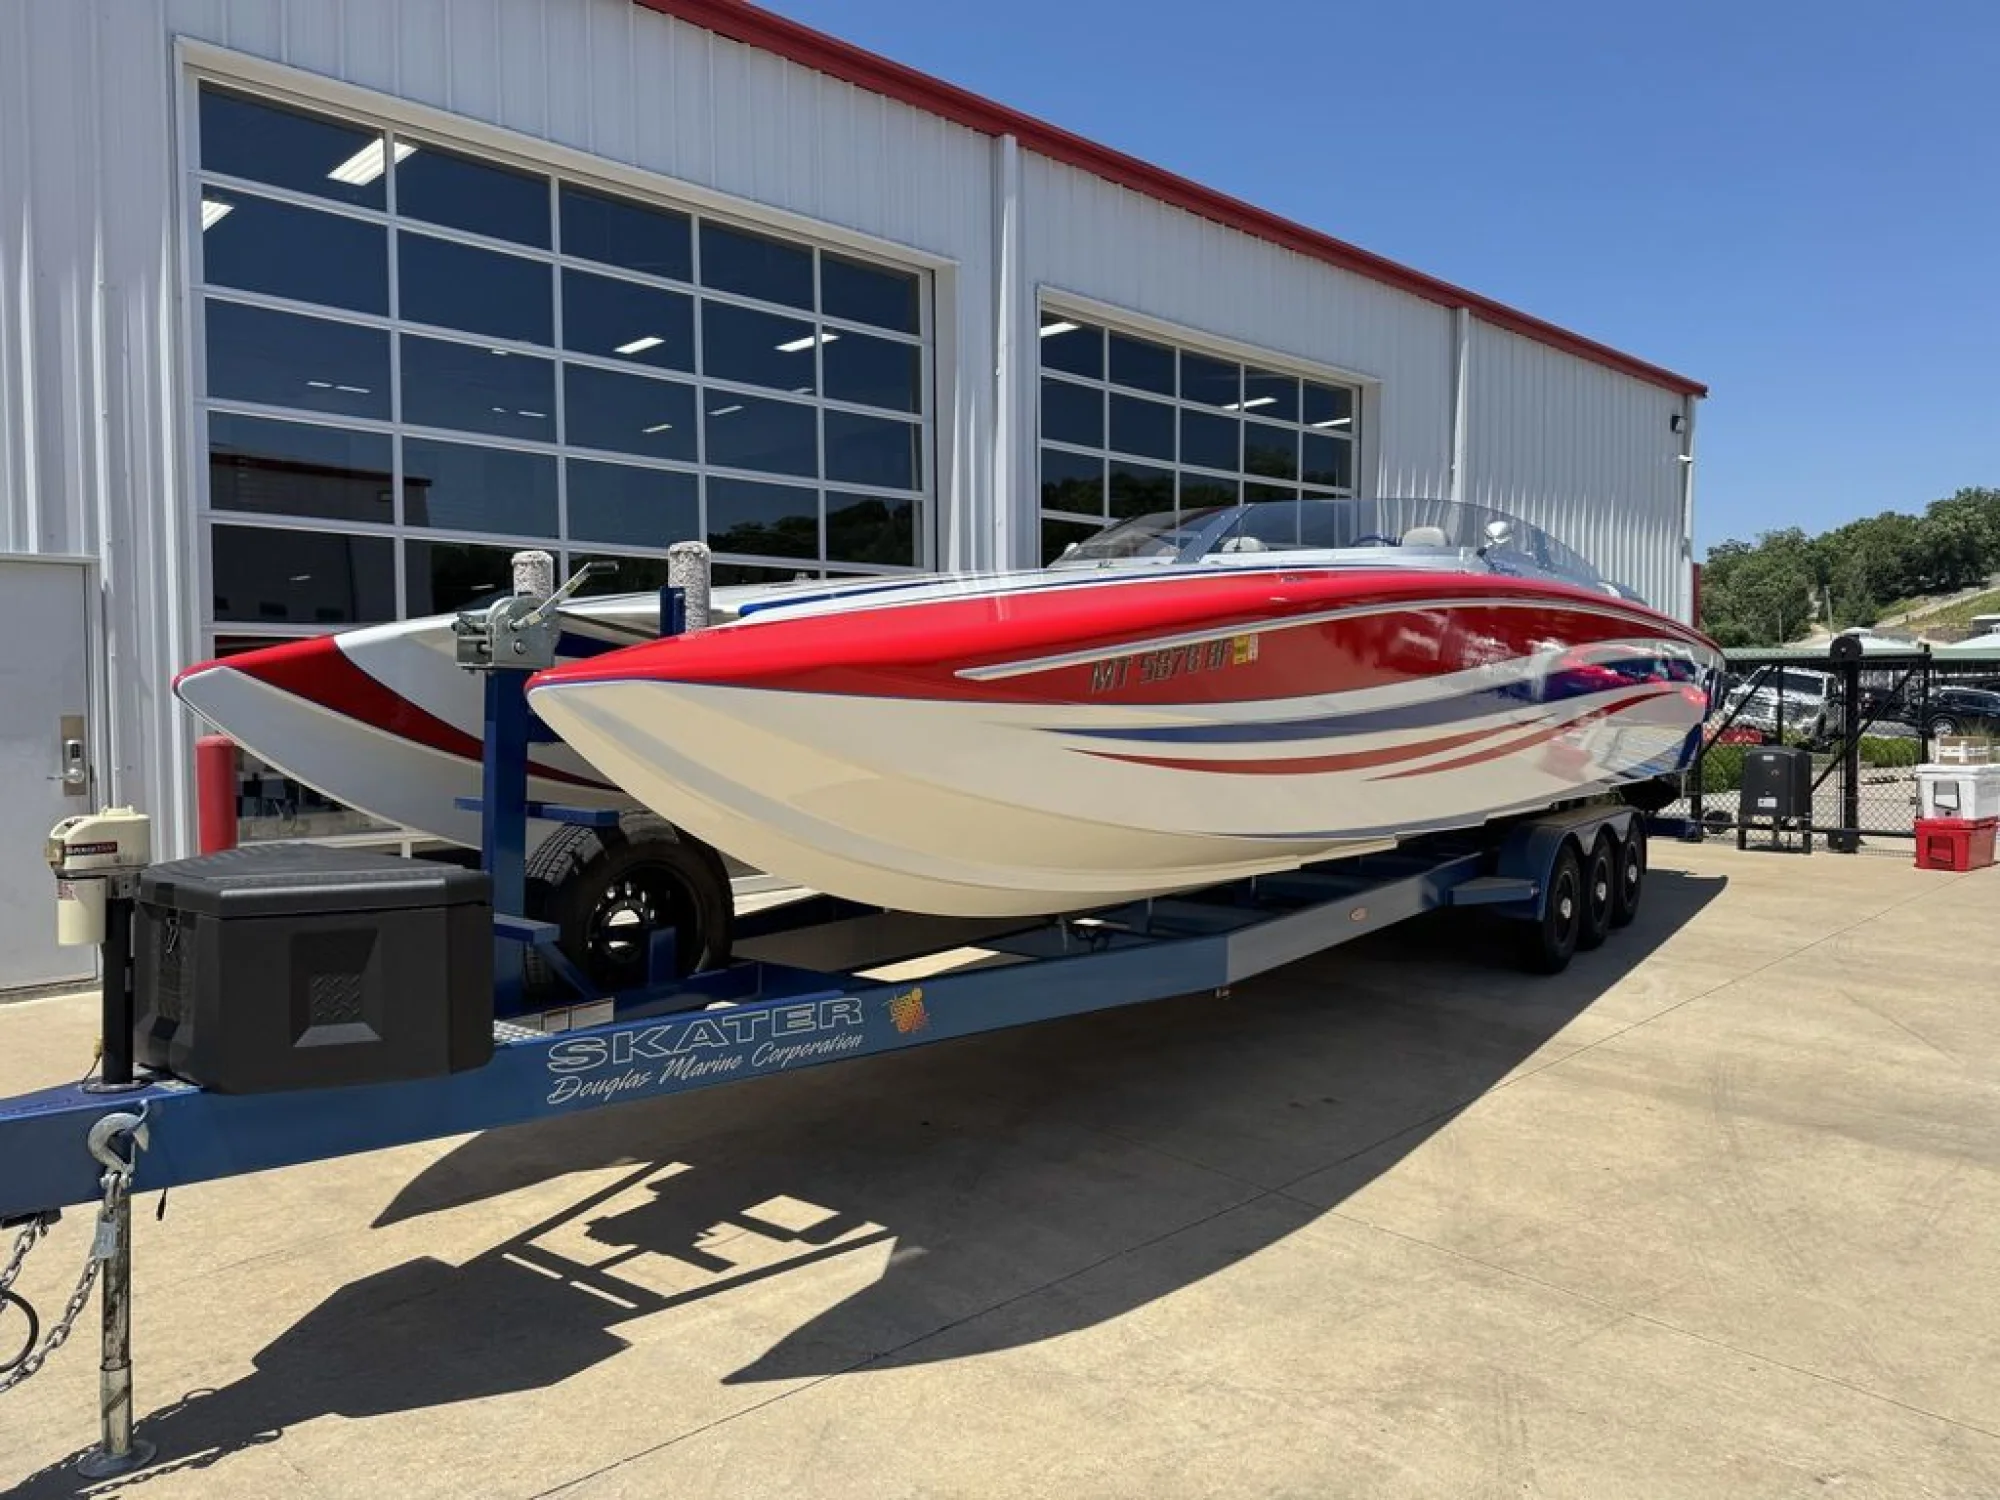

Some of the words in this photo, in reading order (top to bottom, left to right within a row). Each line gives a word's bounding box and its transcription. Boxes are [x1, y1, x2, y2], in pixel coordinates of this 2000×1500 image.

[1091, 656, 1132, 694] MT
[546, 1068, 651, 1105] Douglas
[659, 1054, 744, 1085] Marine
[752, 1033, 864, 1068] Corporation
[547, 998, 864, 1073] SKATER
